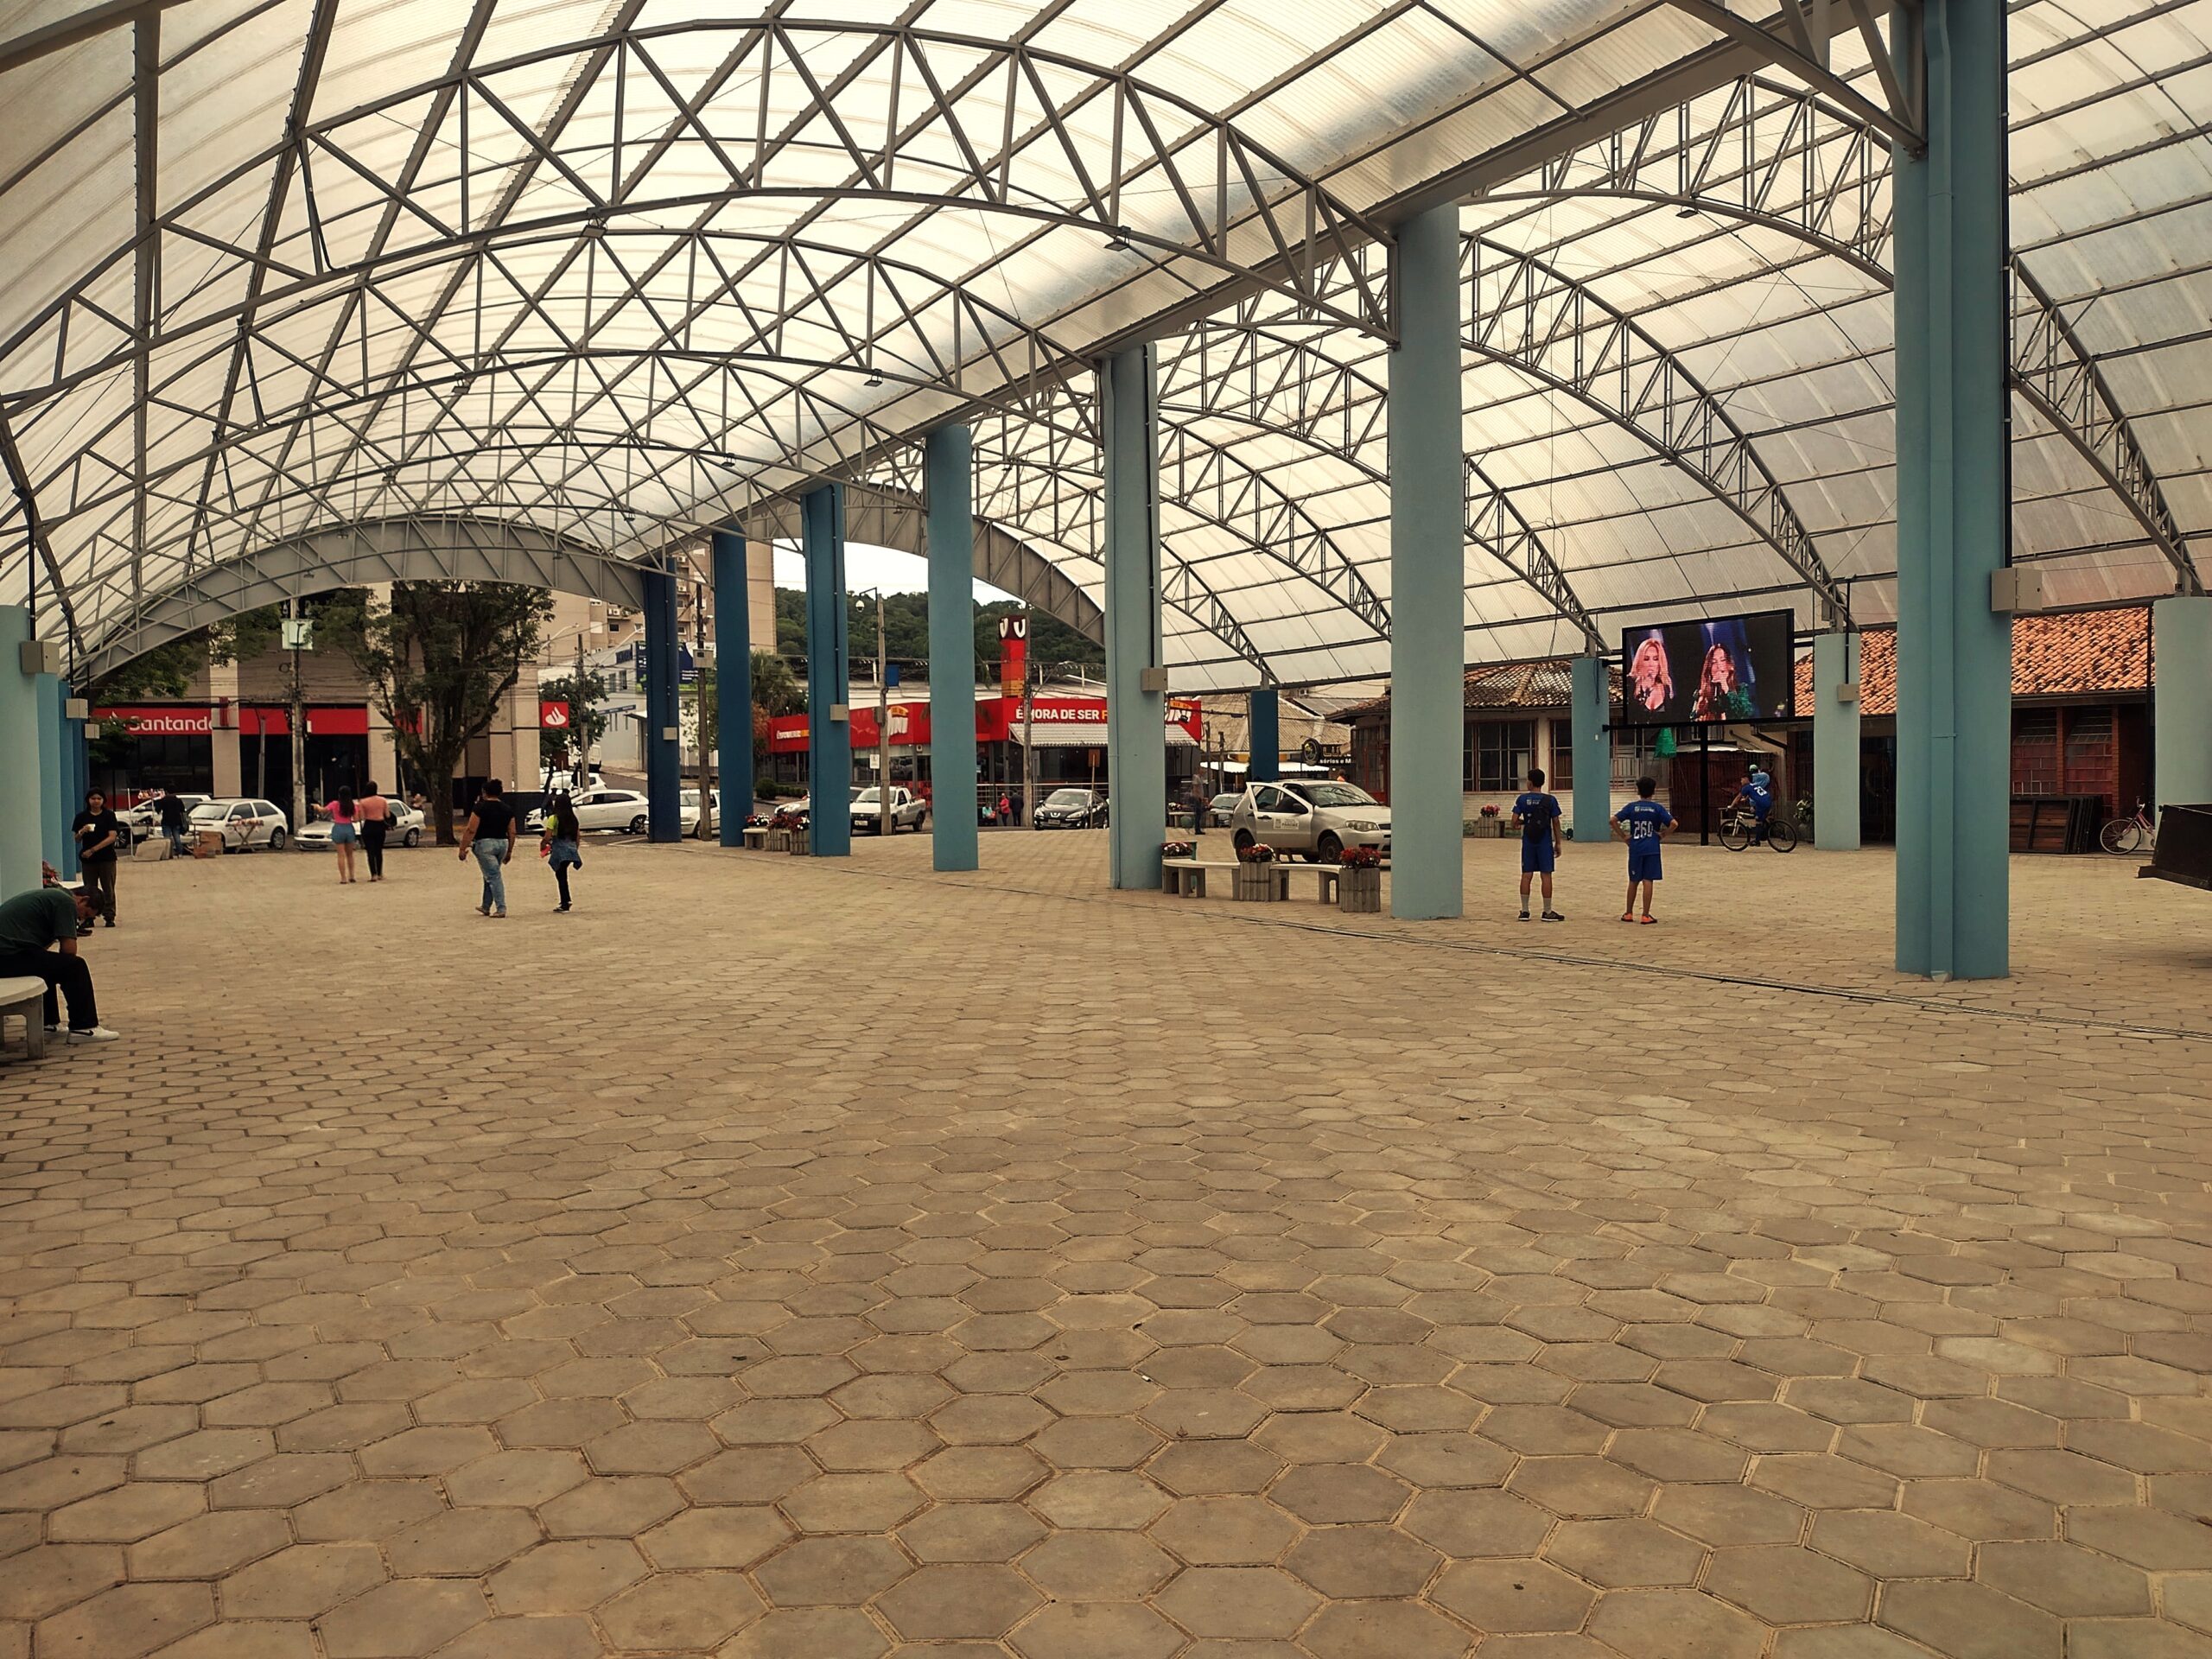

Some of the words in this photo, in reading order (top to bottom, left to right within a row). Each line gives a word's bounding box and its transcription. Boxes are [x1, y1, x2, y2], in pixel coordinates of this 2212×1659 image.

[1060, 709, 1076, 721] DE
[1077, 709, 1100, 721] SER
[1633, 821, 1654, 839] 260
